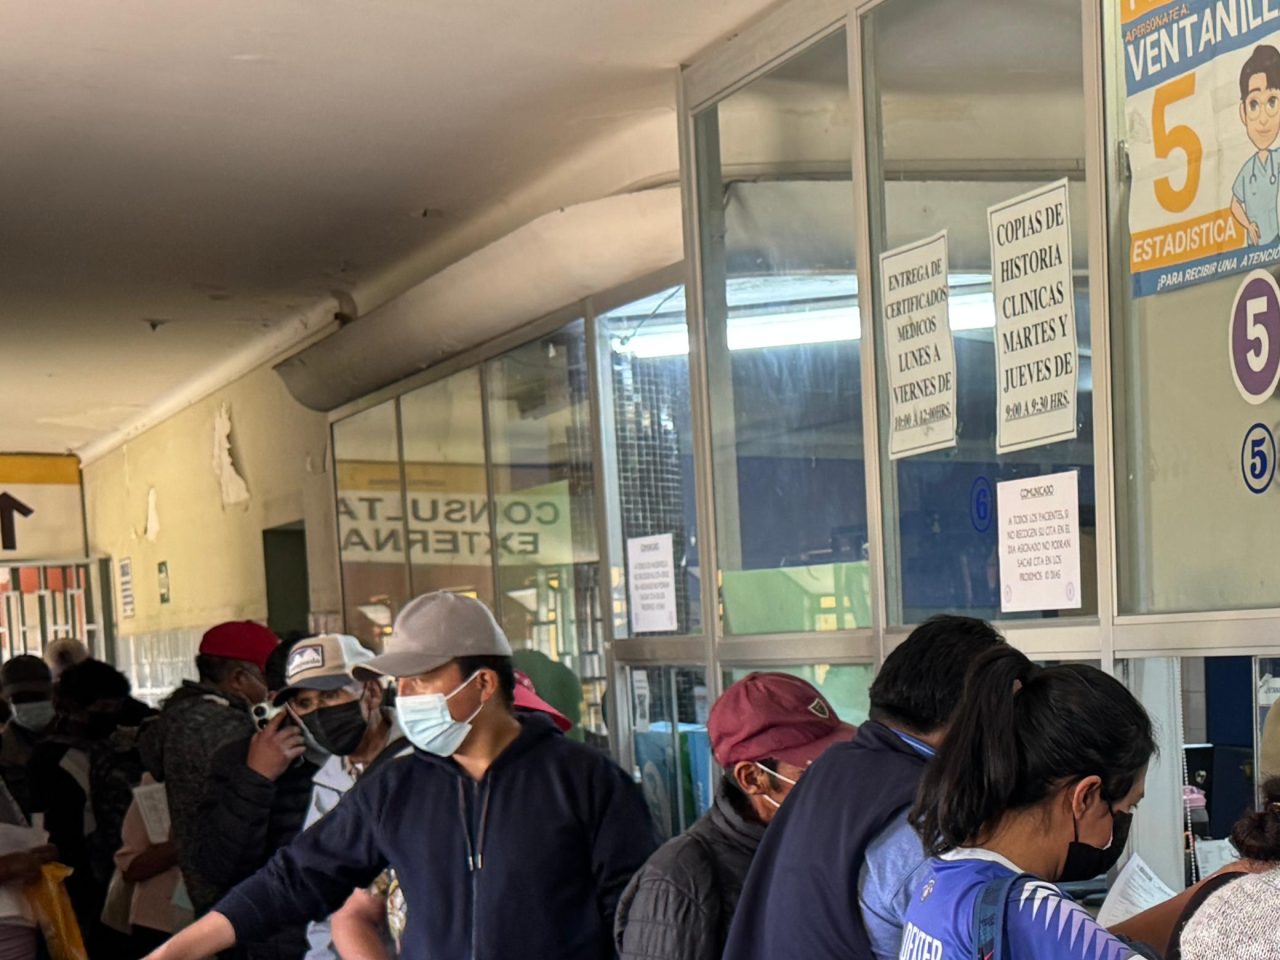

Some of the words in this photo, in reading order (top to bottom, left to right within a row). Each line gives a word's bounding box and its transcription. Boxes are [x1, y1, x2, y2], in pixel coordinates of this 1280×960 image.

[1152, 72, 1202, 213] 5
[997, 210, 1042, 247] COPIAS
[1045, 202, 1064, 230] DE
[1133, 216, 1236, 263] ESTADISTICA
[888, 264, 930, 291] ENTREGA
[931, 258, 943, 277] DE
[1001, 243, 1062, 283] HISTORIA
[1184, 264, 1217, 282] RECIBIR
[1217, 259, 1237, 273] UNA
[885, 285, 948, 320] CERTIFICADOS
[1003, 281, 1064, 319] CLINICAS
[898, 315, 937, 342] MEDICOS
[1003, 318, 1056, 354] MARTES
[1059, 314, 1067, 337] Y
[1246, 296, 1269, 372] 5
[898, 345, 931, 373] LUNES
[933, 343, 941, 362] A
[1004, 357, 1051, 393] JUEVES
[1054, 352, 1072, 377] DE
[893, 376, 936, 404] VIERNES
[938, 371, 951, 393] DE
[1250, 437, 1268, 479] 5
[976, 489, 987, 520] 6
